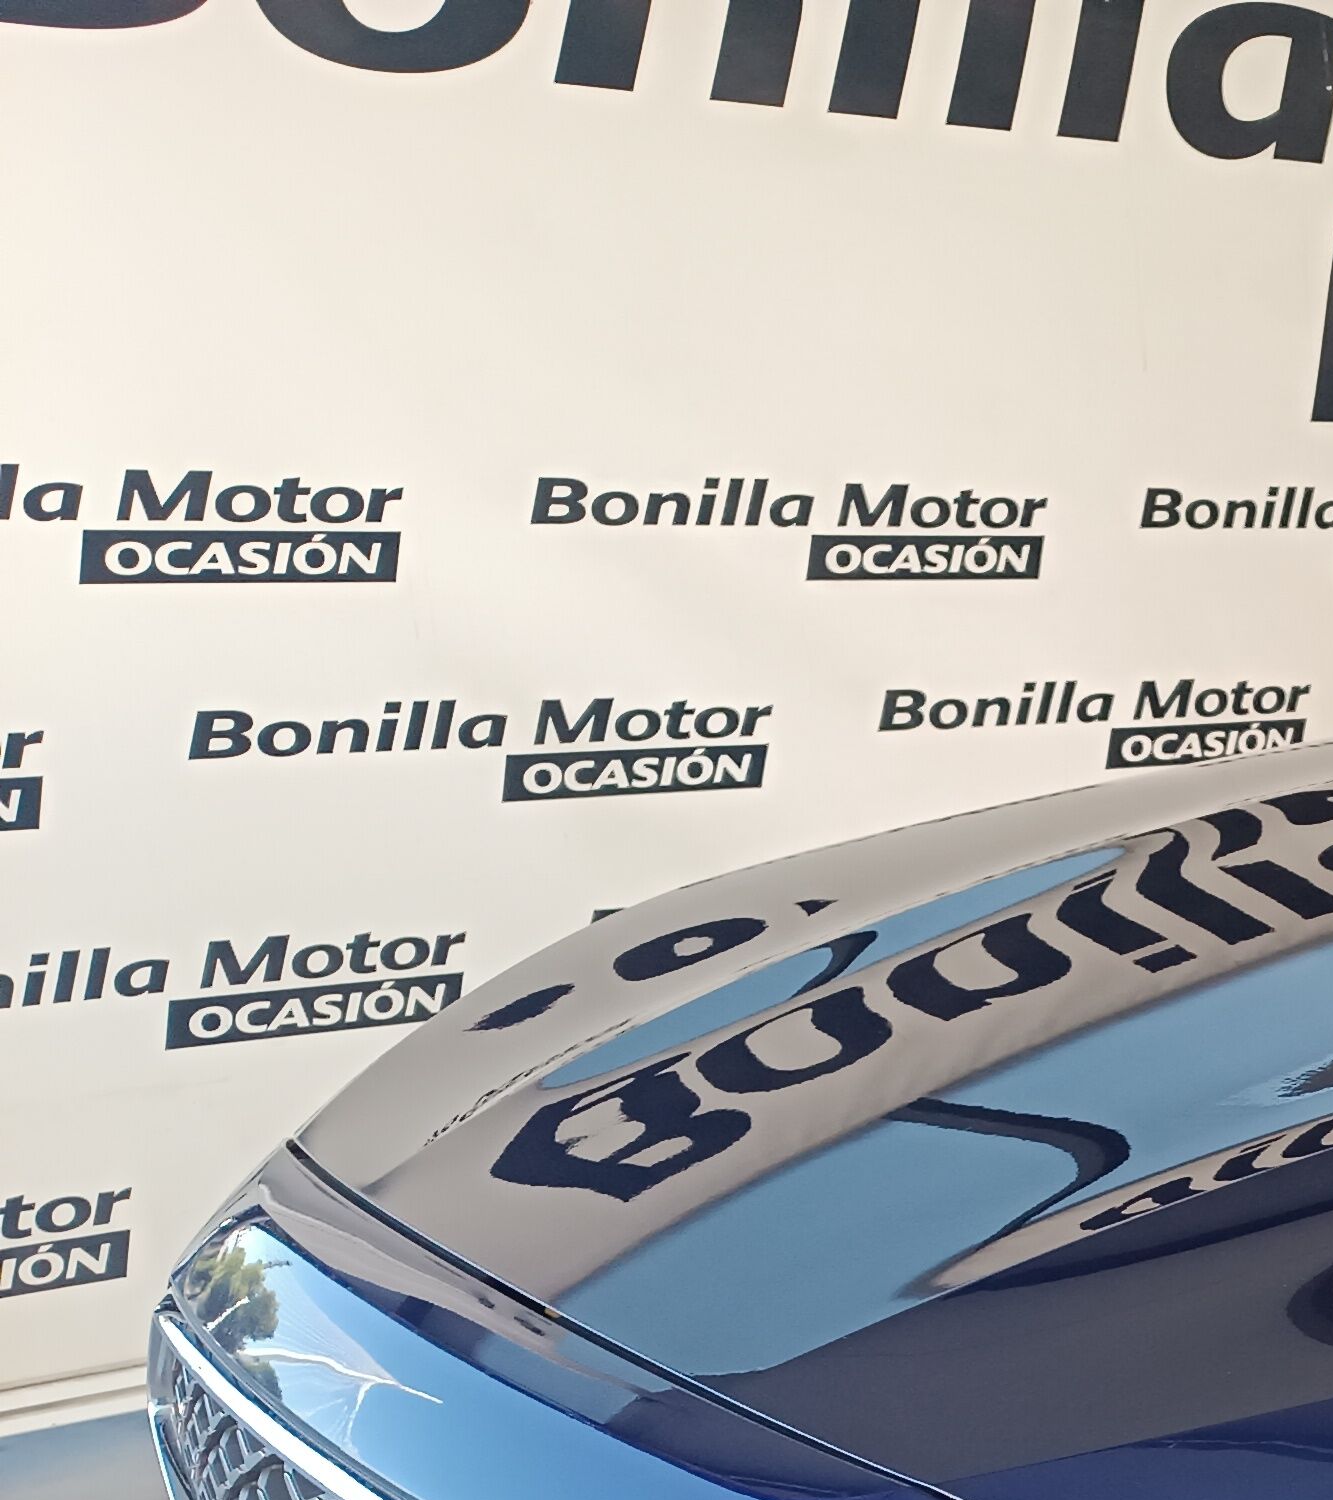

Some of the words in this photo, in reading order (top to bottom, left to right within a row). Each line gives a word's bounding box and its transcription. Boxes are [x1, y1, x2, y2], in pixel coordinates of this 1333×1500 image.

[117, 469, 404, 523] Motor
[531, 477, 815, 526] Bonilla
[837, 483, 1048, 528] Motor
[104, 534, 382, 576] OCASIÓN
[825, 537, 1030, 574] OCASIÓN
[188, 699, 508, 760] Bonilla
[533, 697, 774, 745] Motor
[878, 680, 1115, 732] Bonilla
[1132, 678, 1312, 720] Motor
[1120, 722, 1295, 763] OCASIÓN
[522, 749, 751, 794] OCASIÓN
[201, 931, 467, 989] Motor
[188, 981, 446, 1039] OCASIÓN
